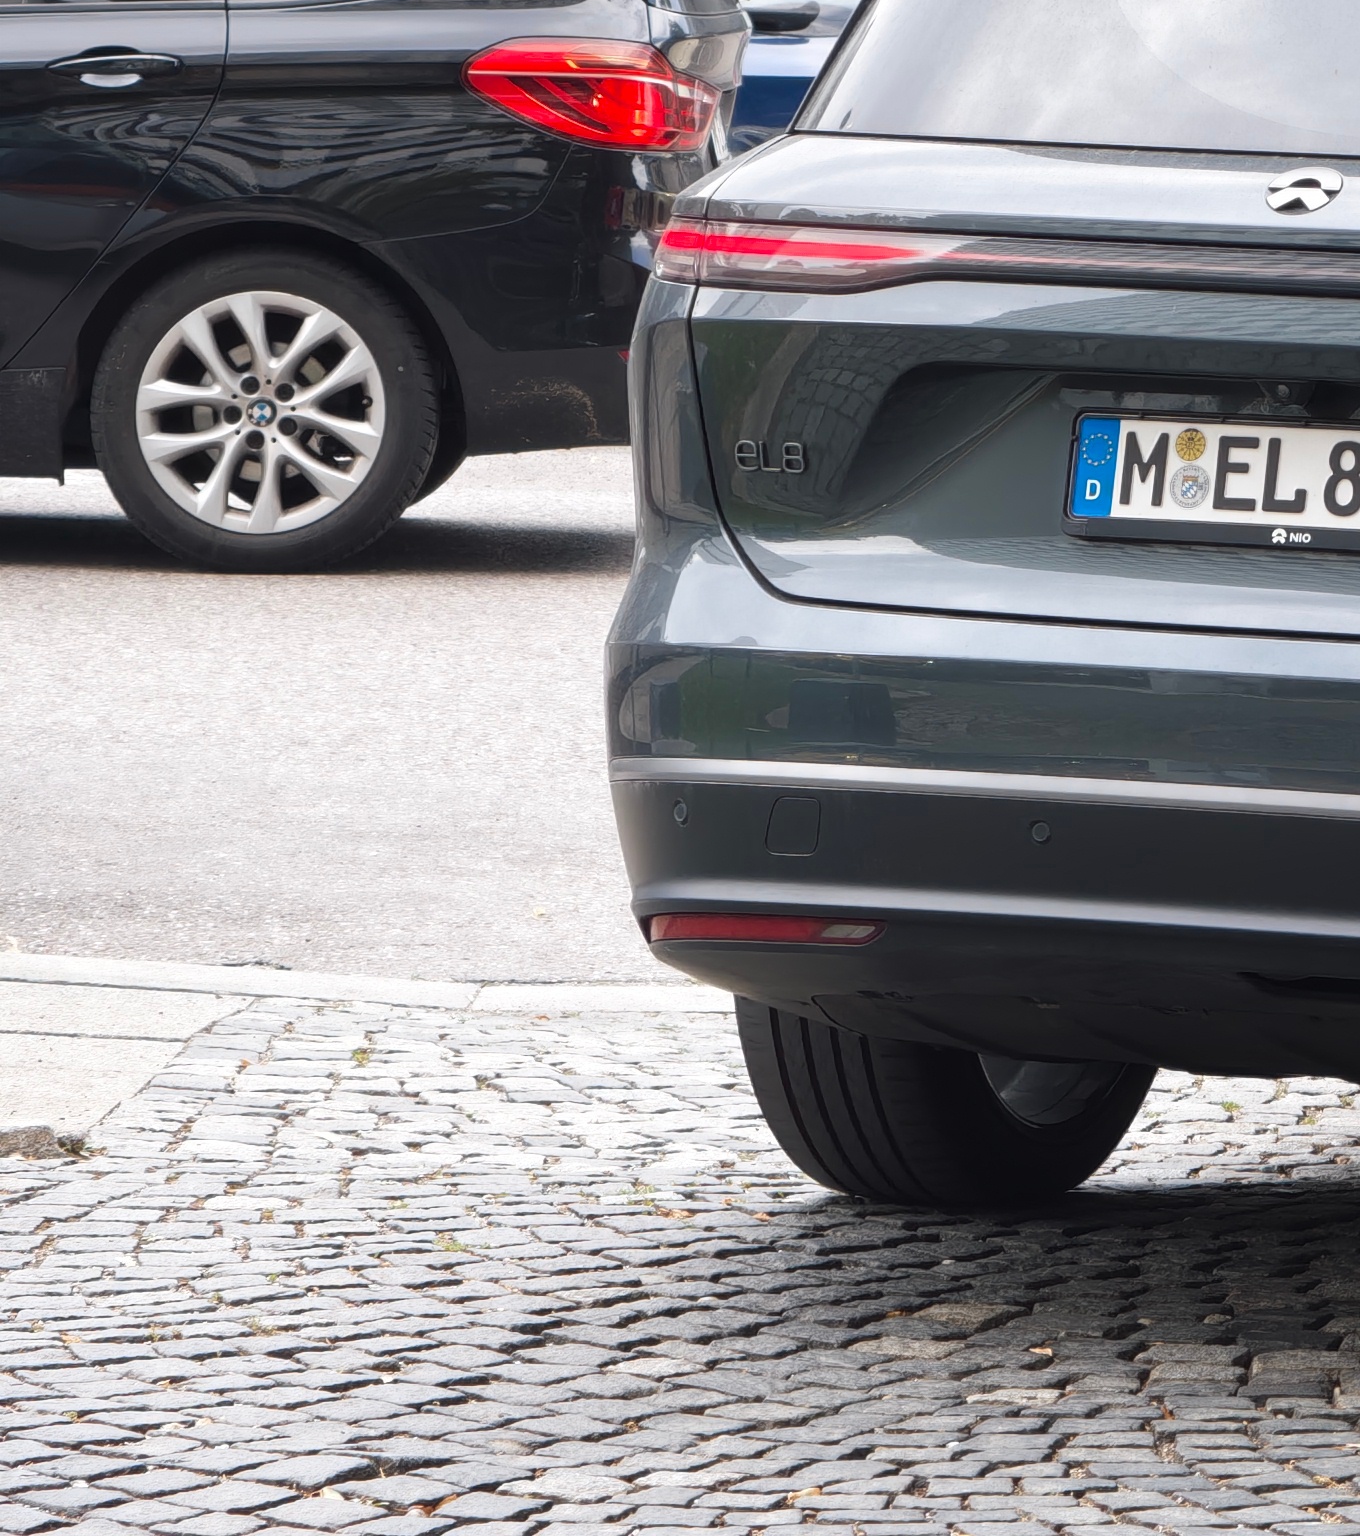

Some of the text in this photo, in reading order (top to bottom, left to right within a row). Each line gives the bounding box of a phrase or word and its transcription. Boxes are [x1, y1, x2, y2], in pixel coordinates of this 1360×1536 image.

[1119, 431, 1170, 507] M
[1212, 435, 1307, 514] EL
[1085, 479, 1101, 501] D
[1289, 532, 1311, 543] NIO
